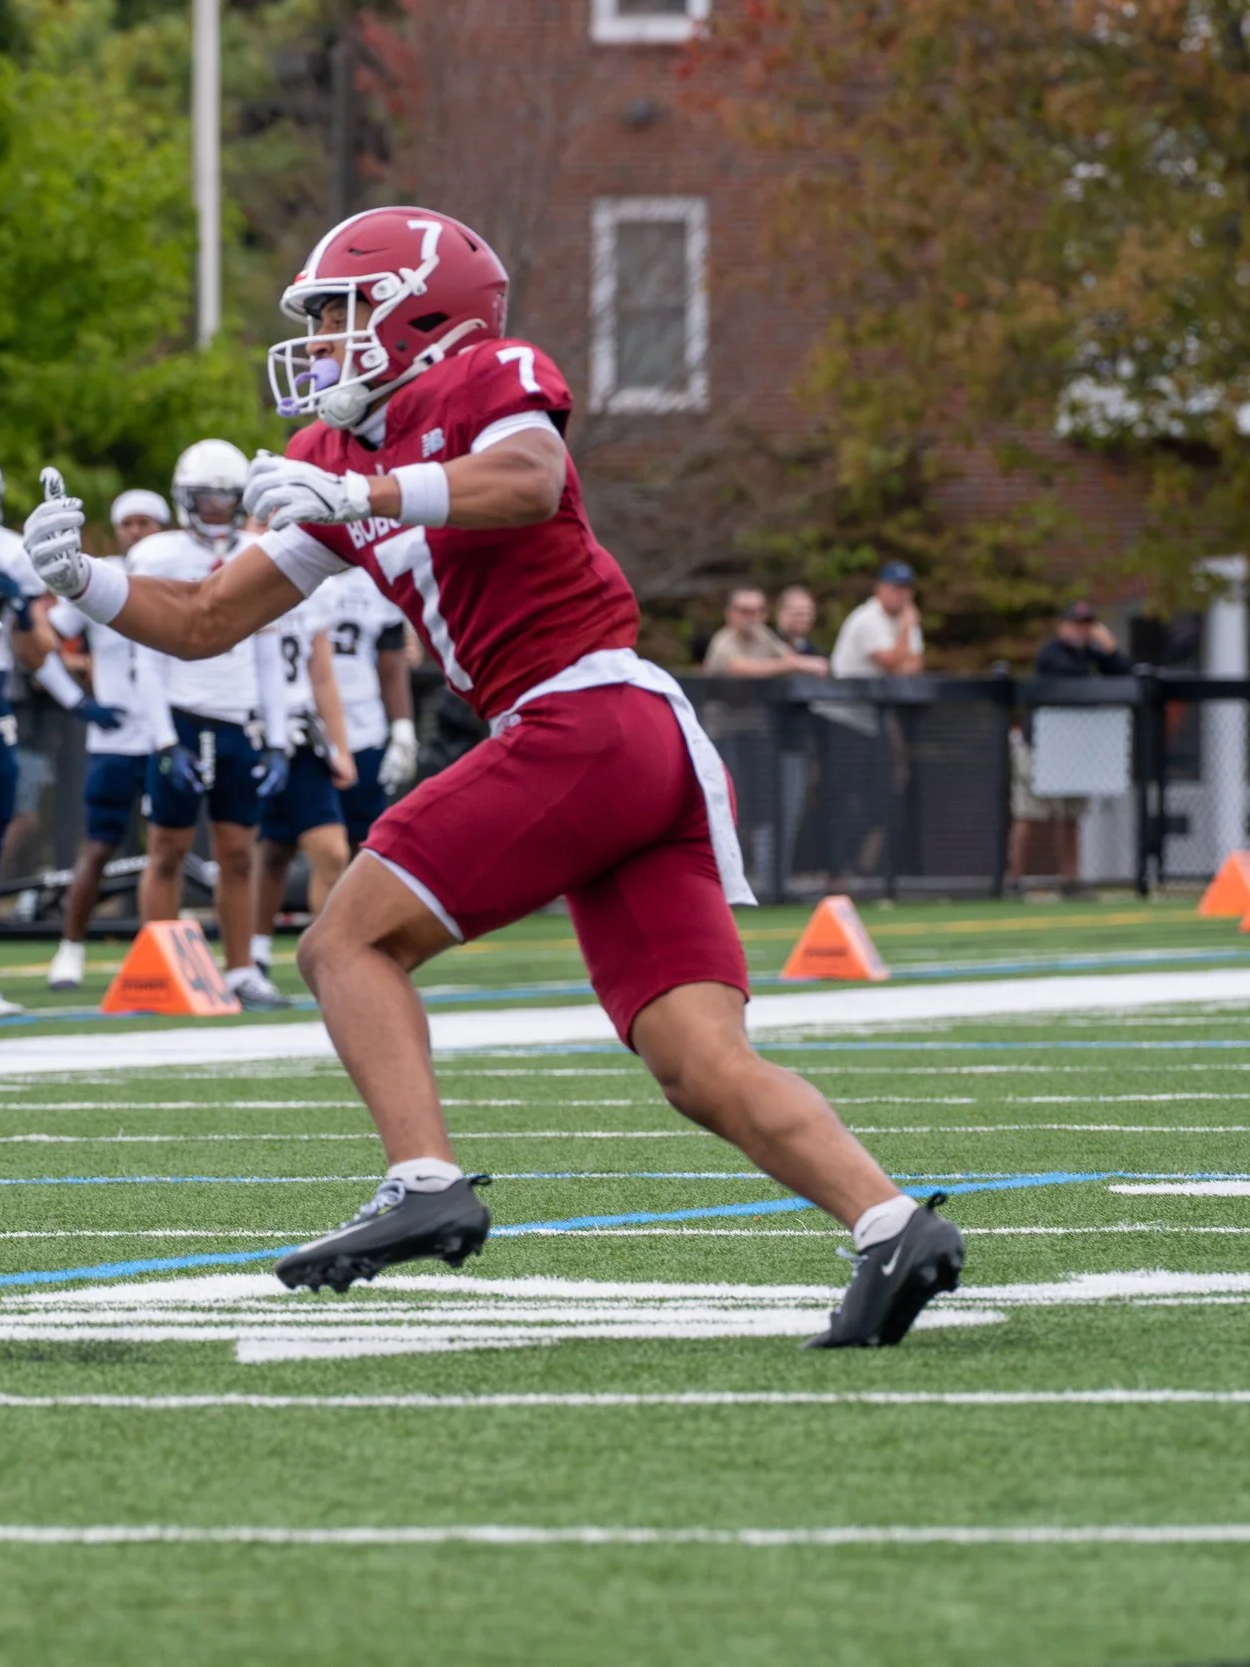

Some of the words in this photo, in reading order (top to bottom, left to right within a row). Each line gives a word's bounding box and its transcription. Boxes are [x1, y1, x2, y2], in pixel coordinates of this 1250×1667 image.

[406, 220, 443, 262] 7
[496, 346, 541, 394] 7
[373, 525, 473, 692] 7
